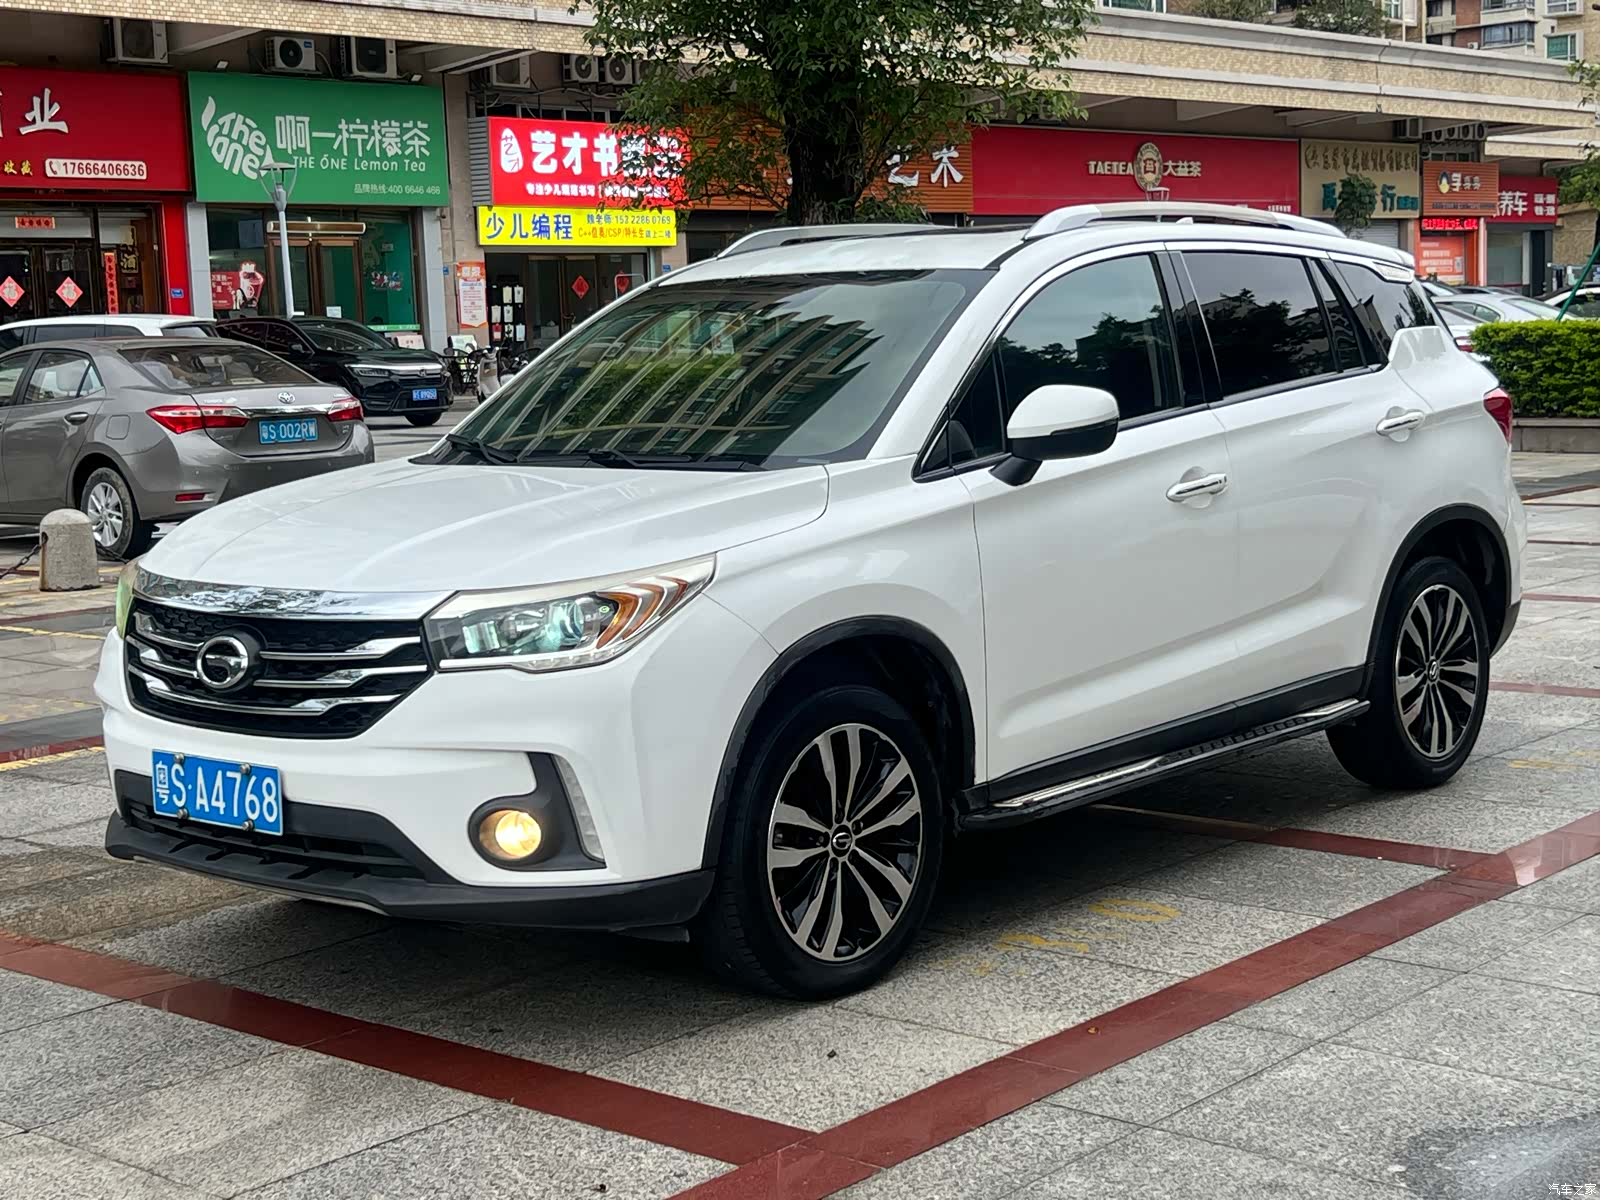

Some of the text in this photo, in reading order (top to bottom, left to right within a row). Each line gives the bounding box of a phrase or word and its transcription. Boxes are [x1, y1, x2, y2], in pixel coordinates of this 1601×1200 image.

[0, 87, 69, 138] 业
[275, 114, 430, 158] 啊一柠檬茶
[62, 162, 145, 177] 17666406636
[293, 157, 314, 169] THE
[354, 158, 398, 171] Lemon
[404, 159, 426, 172] Tea
[1088, 161, 1133, 174] TAETEA
[1163, 160, 1201, 177] 大益茶
[1493, 191, 1528, 218] 养车
[486, 213, 573, 241] 少儿编程
